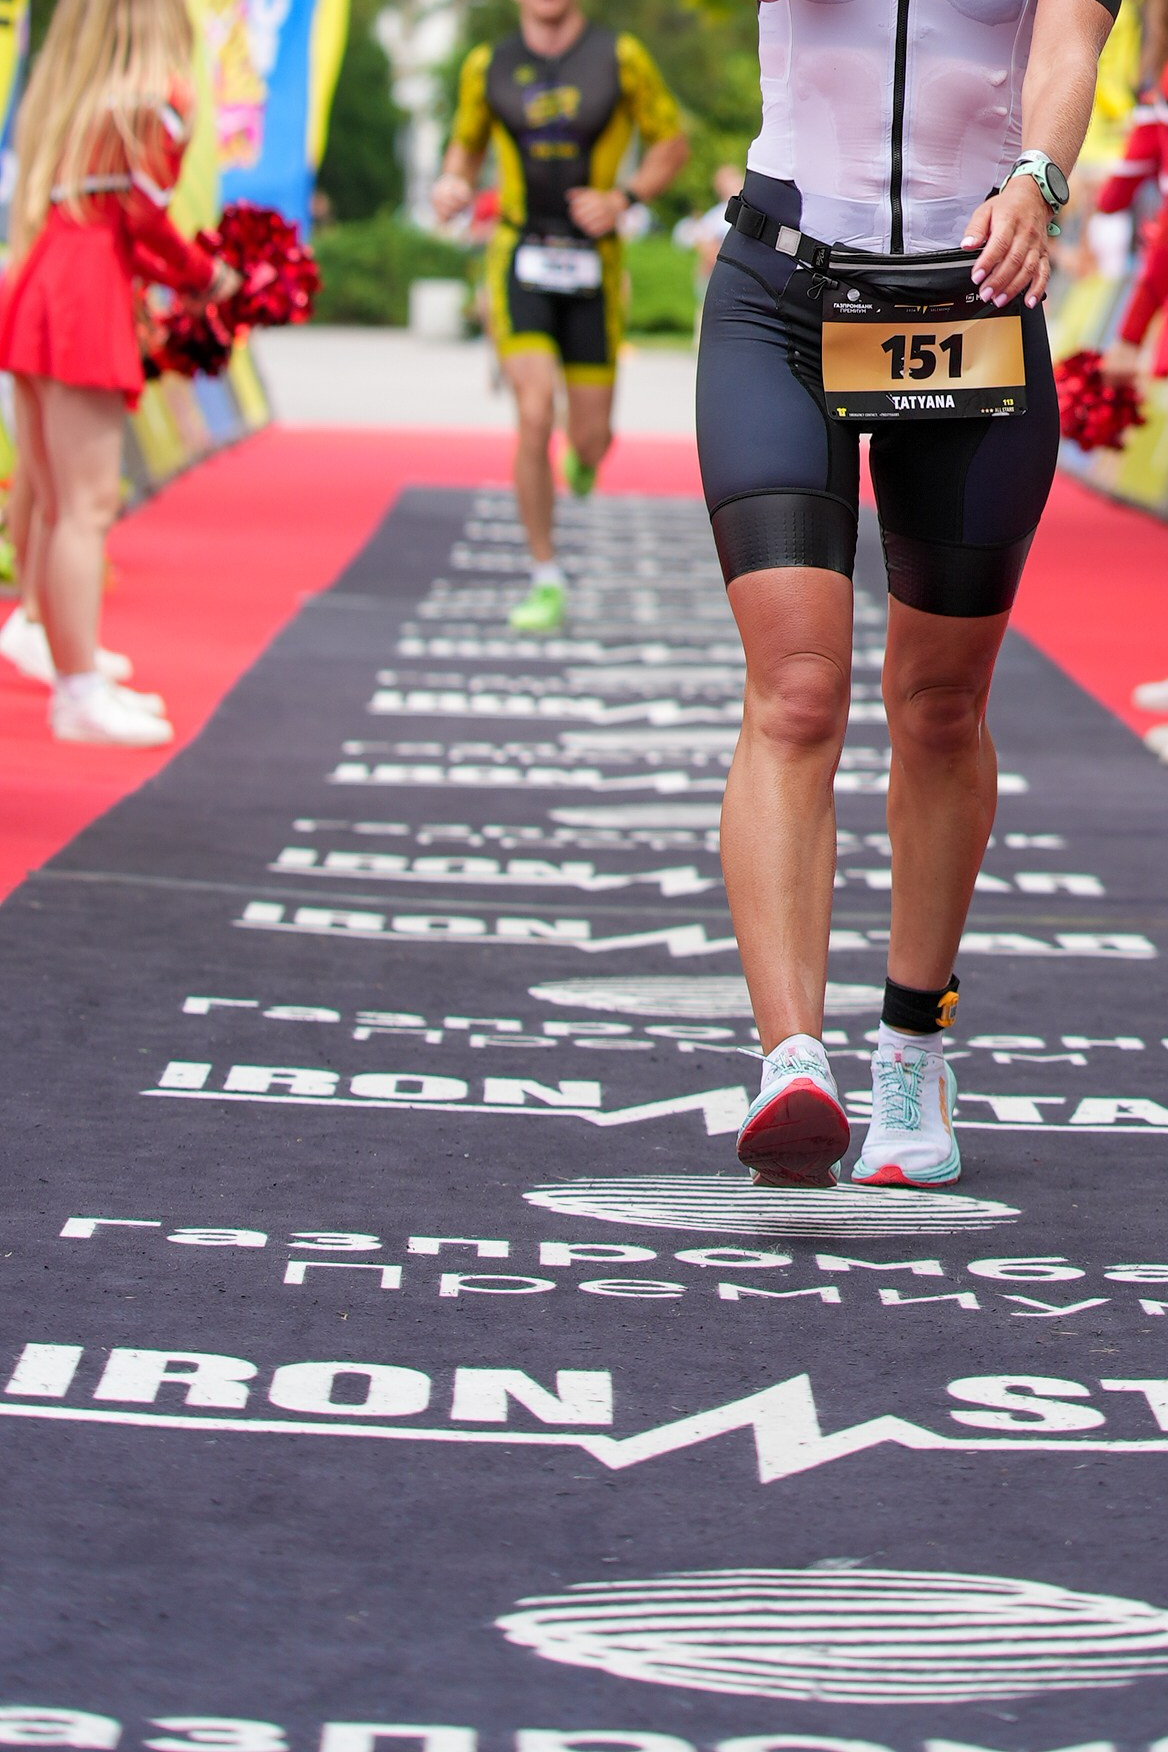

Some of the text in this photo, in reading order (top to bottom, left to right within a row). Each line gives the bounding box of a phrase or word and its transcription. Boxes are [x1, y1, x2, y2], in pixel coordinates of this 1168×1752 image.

[880, 333, 963, 380] 151
[892, 395, 955, 410] TATYANA
[158, 1061, 603, 1106] IRON
[4, 1342, 614, 1425] IRON
